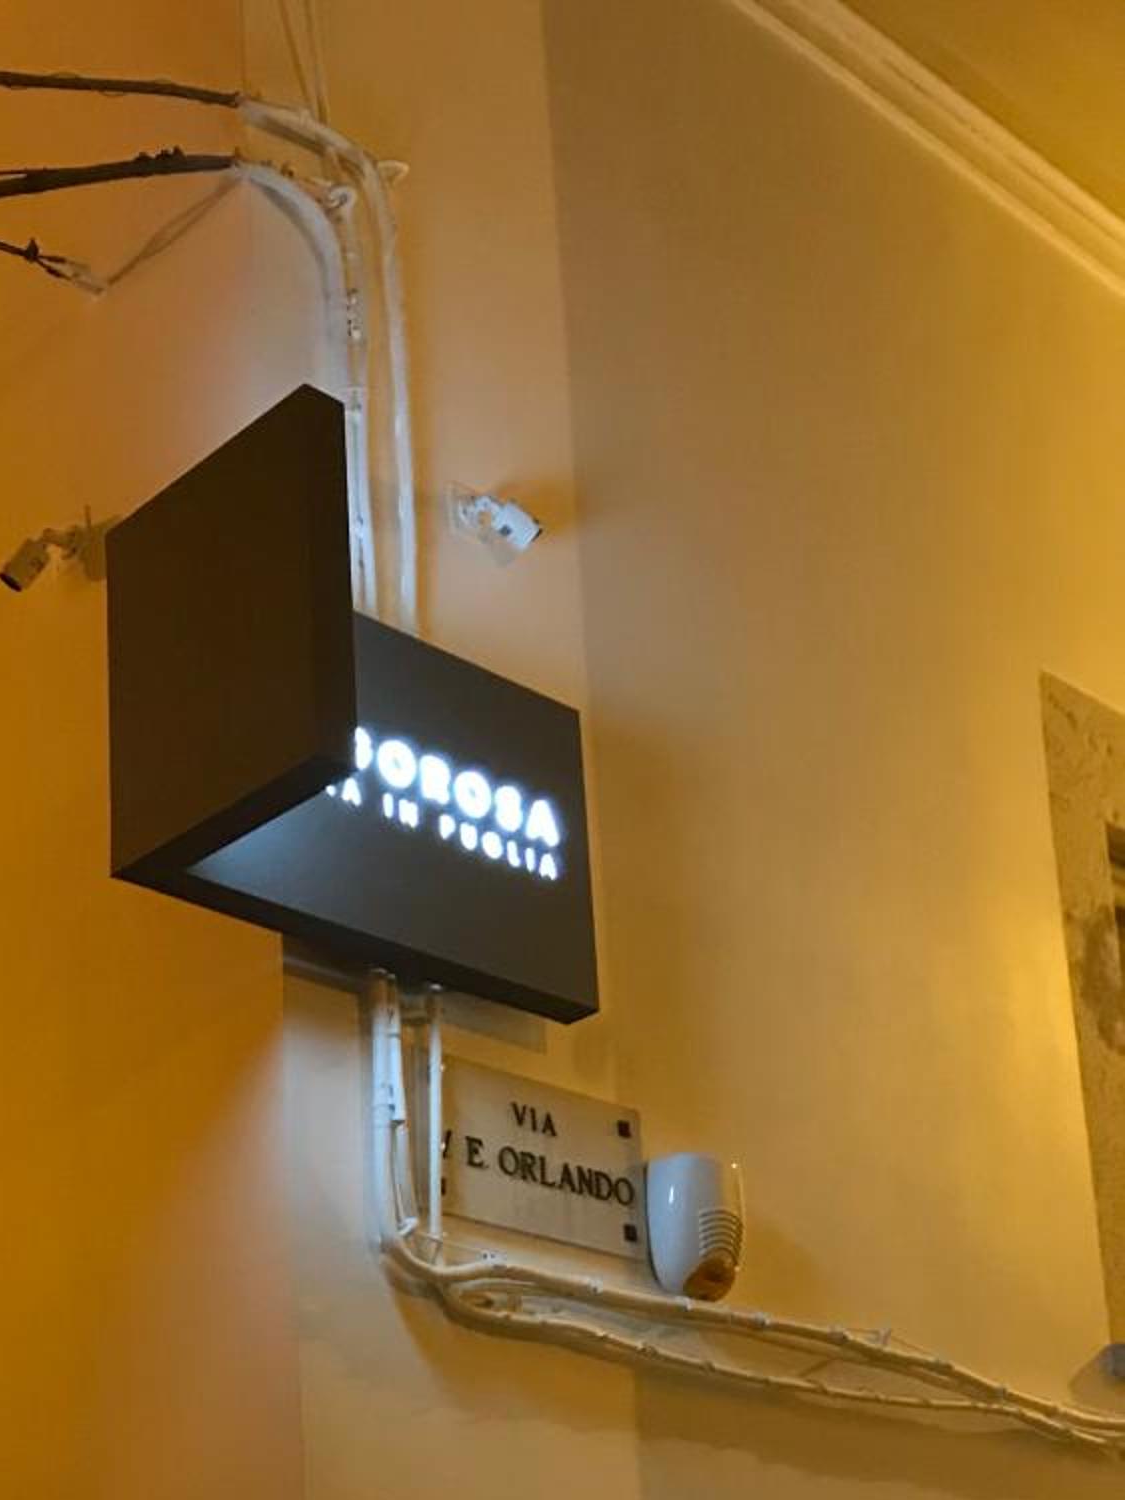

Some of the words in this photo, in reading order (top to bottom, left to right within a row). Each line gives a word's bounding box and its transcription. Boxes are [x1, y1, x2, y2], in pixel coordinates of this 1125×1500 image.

[382, 792, 420, 829] IN
[437, 813, 559, 881] PUGLIA
[510, 1101, 558, 1138] VIA
[497, 1145, 636, 1207] ORLANDO
